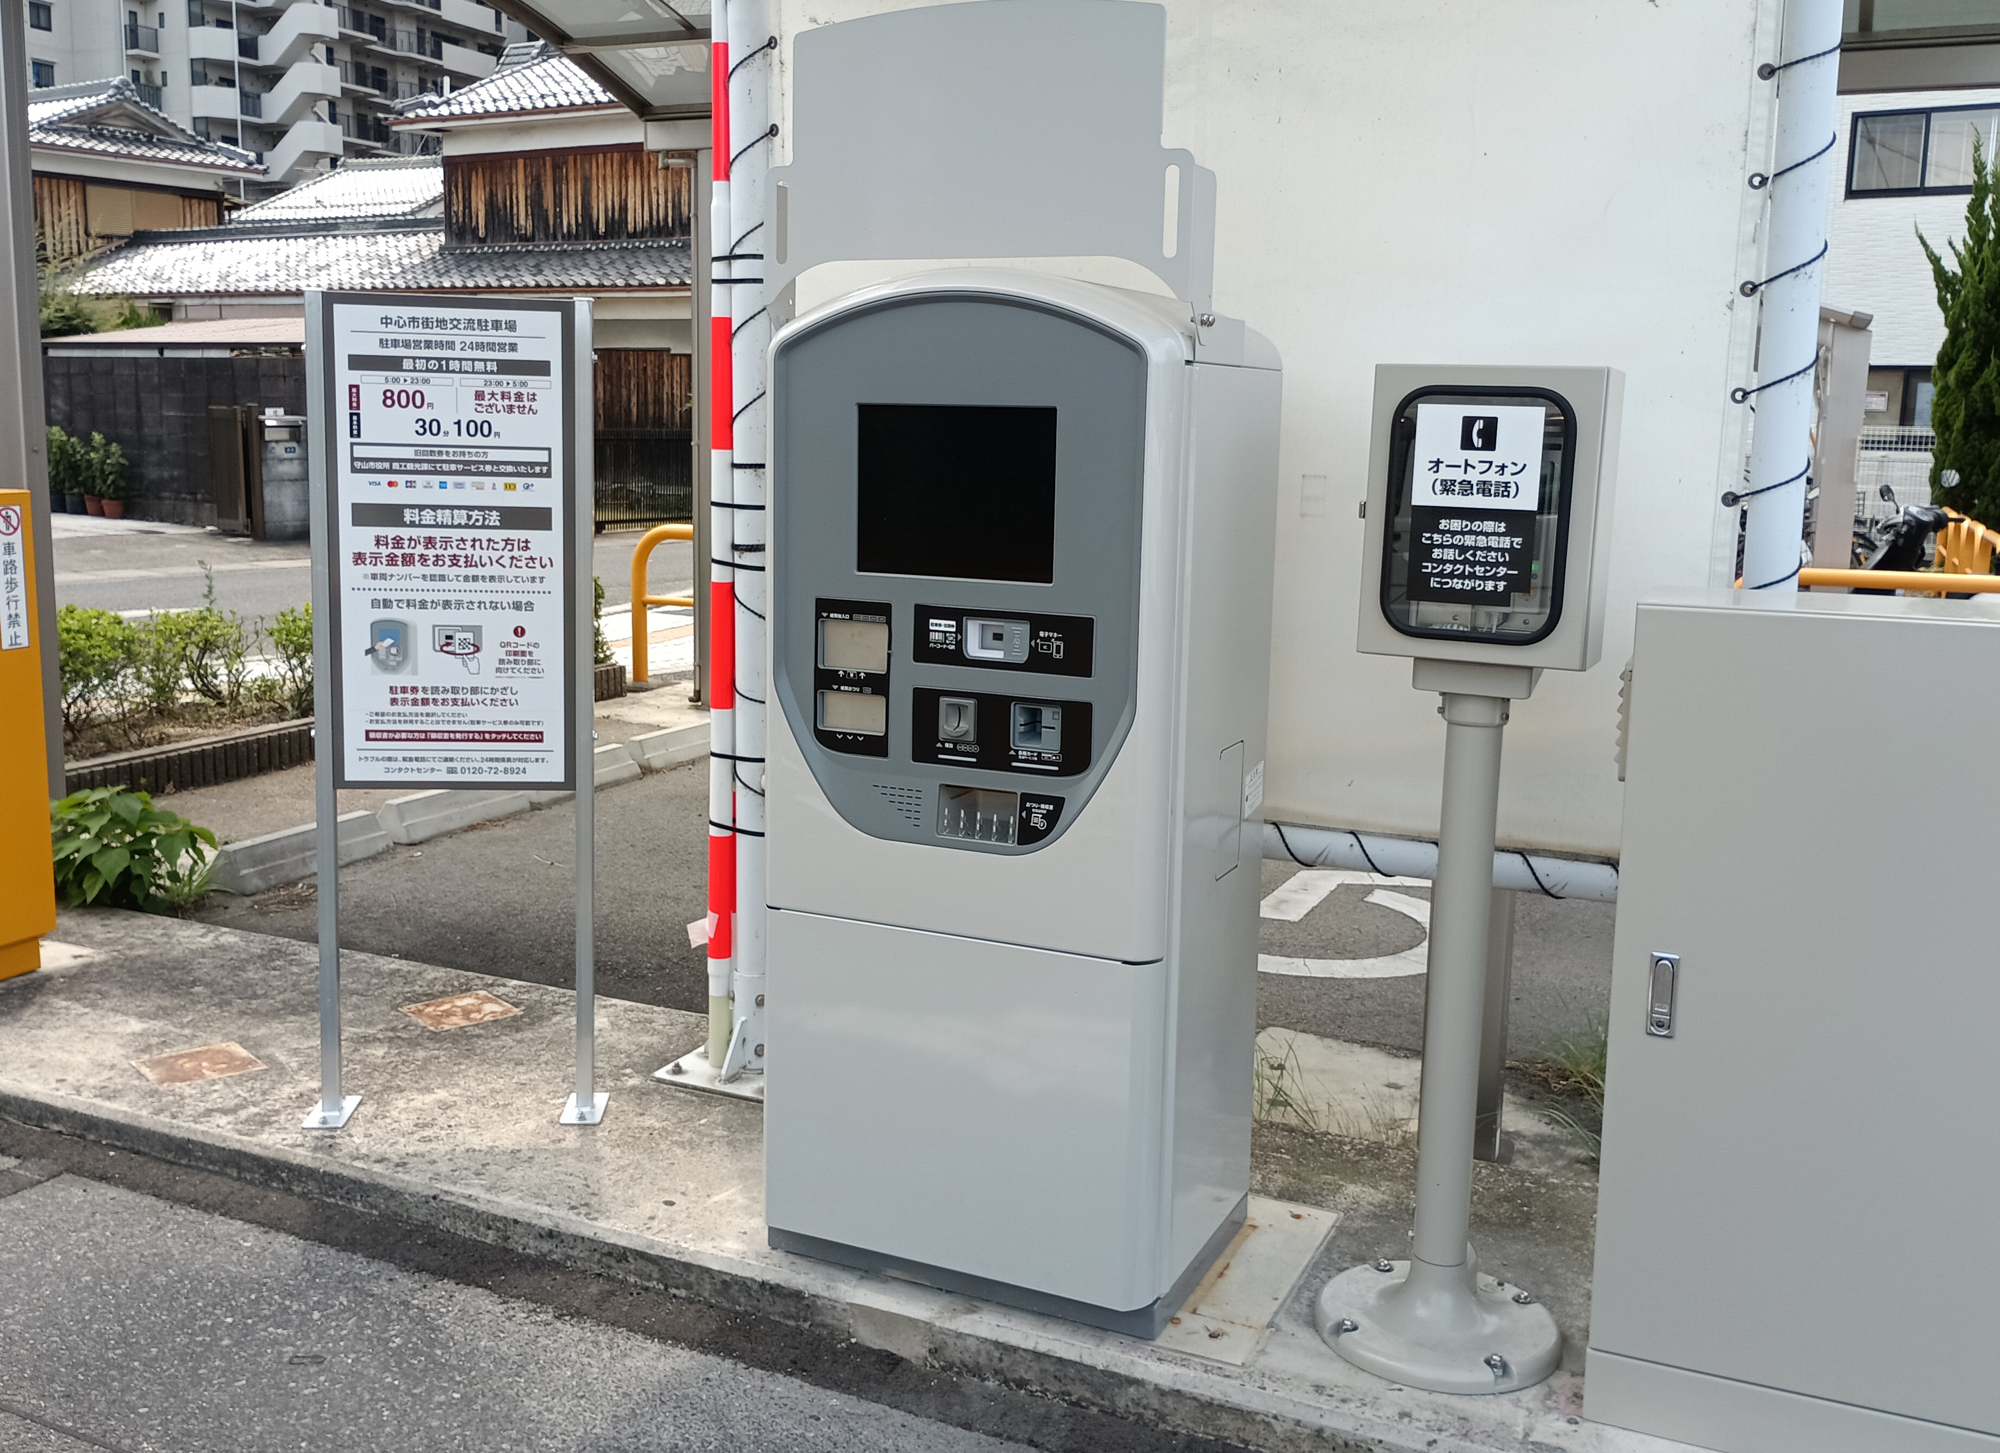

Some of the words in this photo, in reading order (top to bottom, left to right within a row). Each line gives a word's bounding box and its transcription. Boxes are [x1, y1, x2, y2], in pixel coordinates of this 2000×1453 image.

[380, 315, 517, 333] 中心市街地交流駐車場
[378, 338, 456, 351] 駐車場営業時間
[460, 341, 519, 353] 24時間営業
[402, 358, 498, 373] 最初の1時間無料
[410, 377, 431, 385] 23:00
[474, 390, 538, 403] 最大料金は
[474, 402, 538, 415] ございません
[1427, 457, 1527, 477] オートフォン
[1431, 478, 1520, 499] （緊急電話）
[403, 508, 501, 527] 料金精算方法
[1438, 518, 1506, 534] お困りの際は
[374, 534, 532, 552] 料金が表示された方は
[1421, 532, 1523, 549] こちらの緊急電話で
[352, 551, 554, 570] 表示金額をお支払いください
[1431, 548, 1510, 562] お話しください
[1421, 562, 1519, 577] コンタクトセンター
[1429, 576, 1507, 592] につながります
[2, 541, 23, 647] 車路歩行禁止
[371, 598, 535, 612] 自動で料金が表示されない場合
[499, 641, 541, 649] QRコードの
[498, 658, 542, 666] 読み取り部に
[389, 685, 519, 697] 駐車券を読み取り部にかざし
[389, 697, 519, 708] 表示金額をお支払いください
[384, 766, 443, 774] コンタクトセンター
[460, 766, 527, 775] 0120-72-8924
